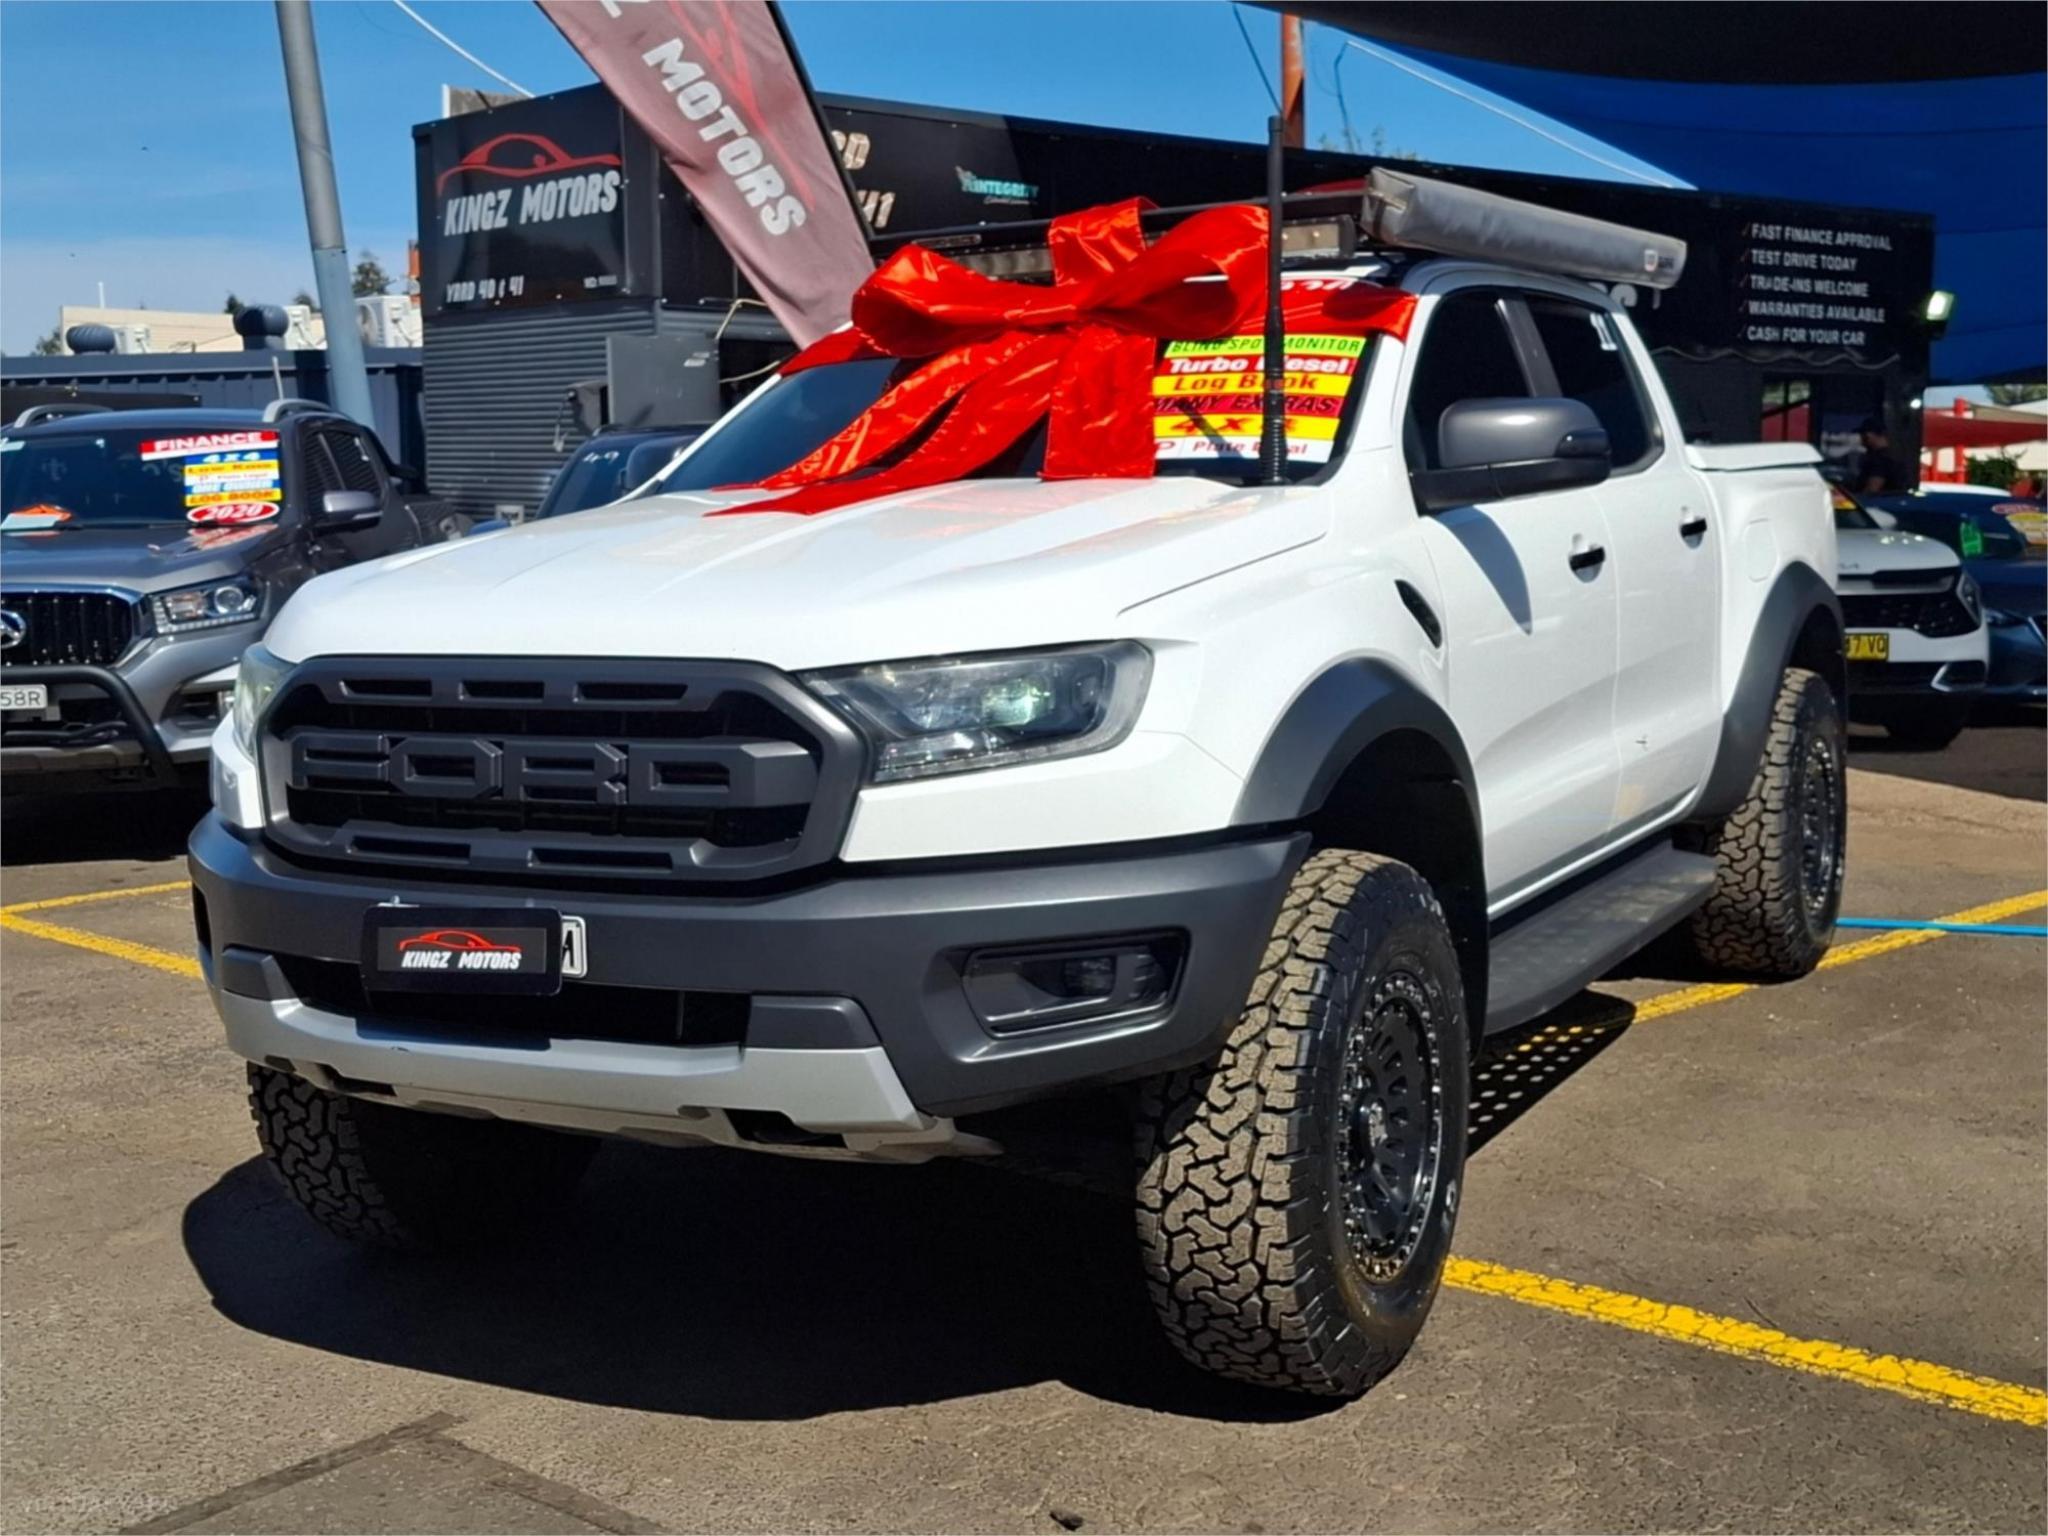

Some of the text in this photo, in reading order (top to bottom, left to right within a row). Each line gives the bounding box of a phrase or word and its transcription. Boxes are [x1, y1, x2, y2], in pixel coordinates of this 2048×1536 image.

[641, 37, 806, 236] MOTORS
[444, 169, 621, 237] KINGZ MOTORS
[1752, 223, 1893, 251] FAST FINANCE APPROVAL
[1751, 250, 1859, 272] TEST DRIVE TODAY
[1750, 274, 1870, 298] TRADE-INS WELCOME
[1748, 299, 1886, 324] WARRANTIES AVAILABLE
[1746, 325, 1866, 346] CASH FOR YOUR CAR
[1169, 356, 1250, 374] Turbo
[1173, 376, 1228, 392] Log
[154, 432, 262, 452] FINANCE
[208, 504, 263, 521] 2020
[401, 952, 522, 969] KINGZ MOTORS
